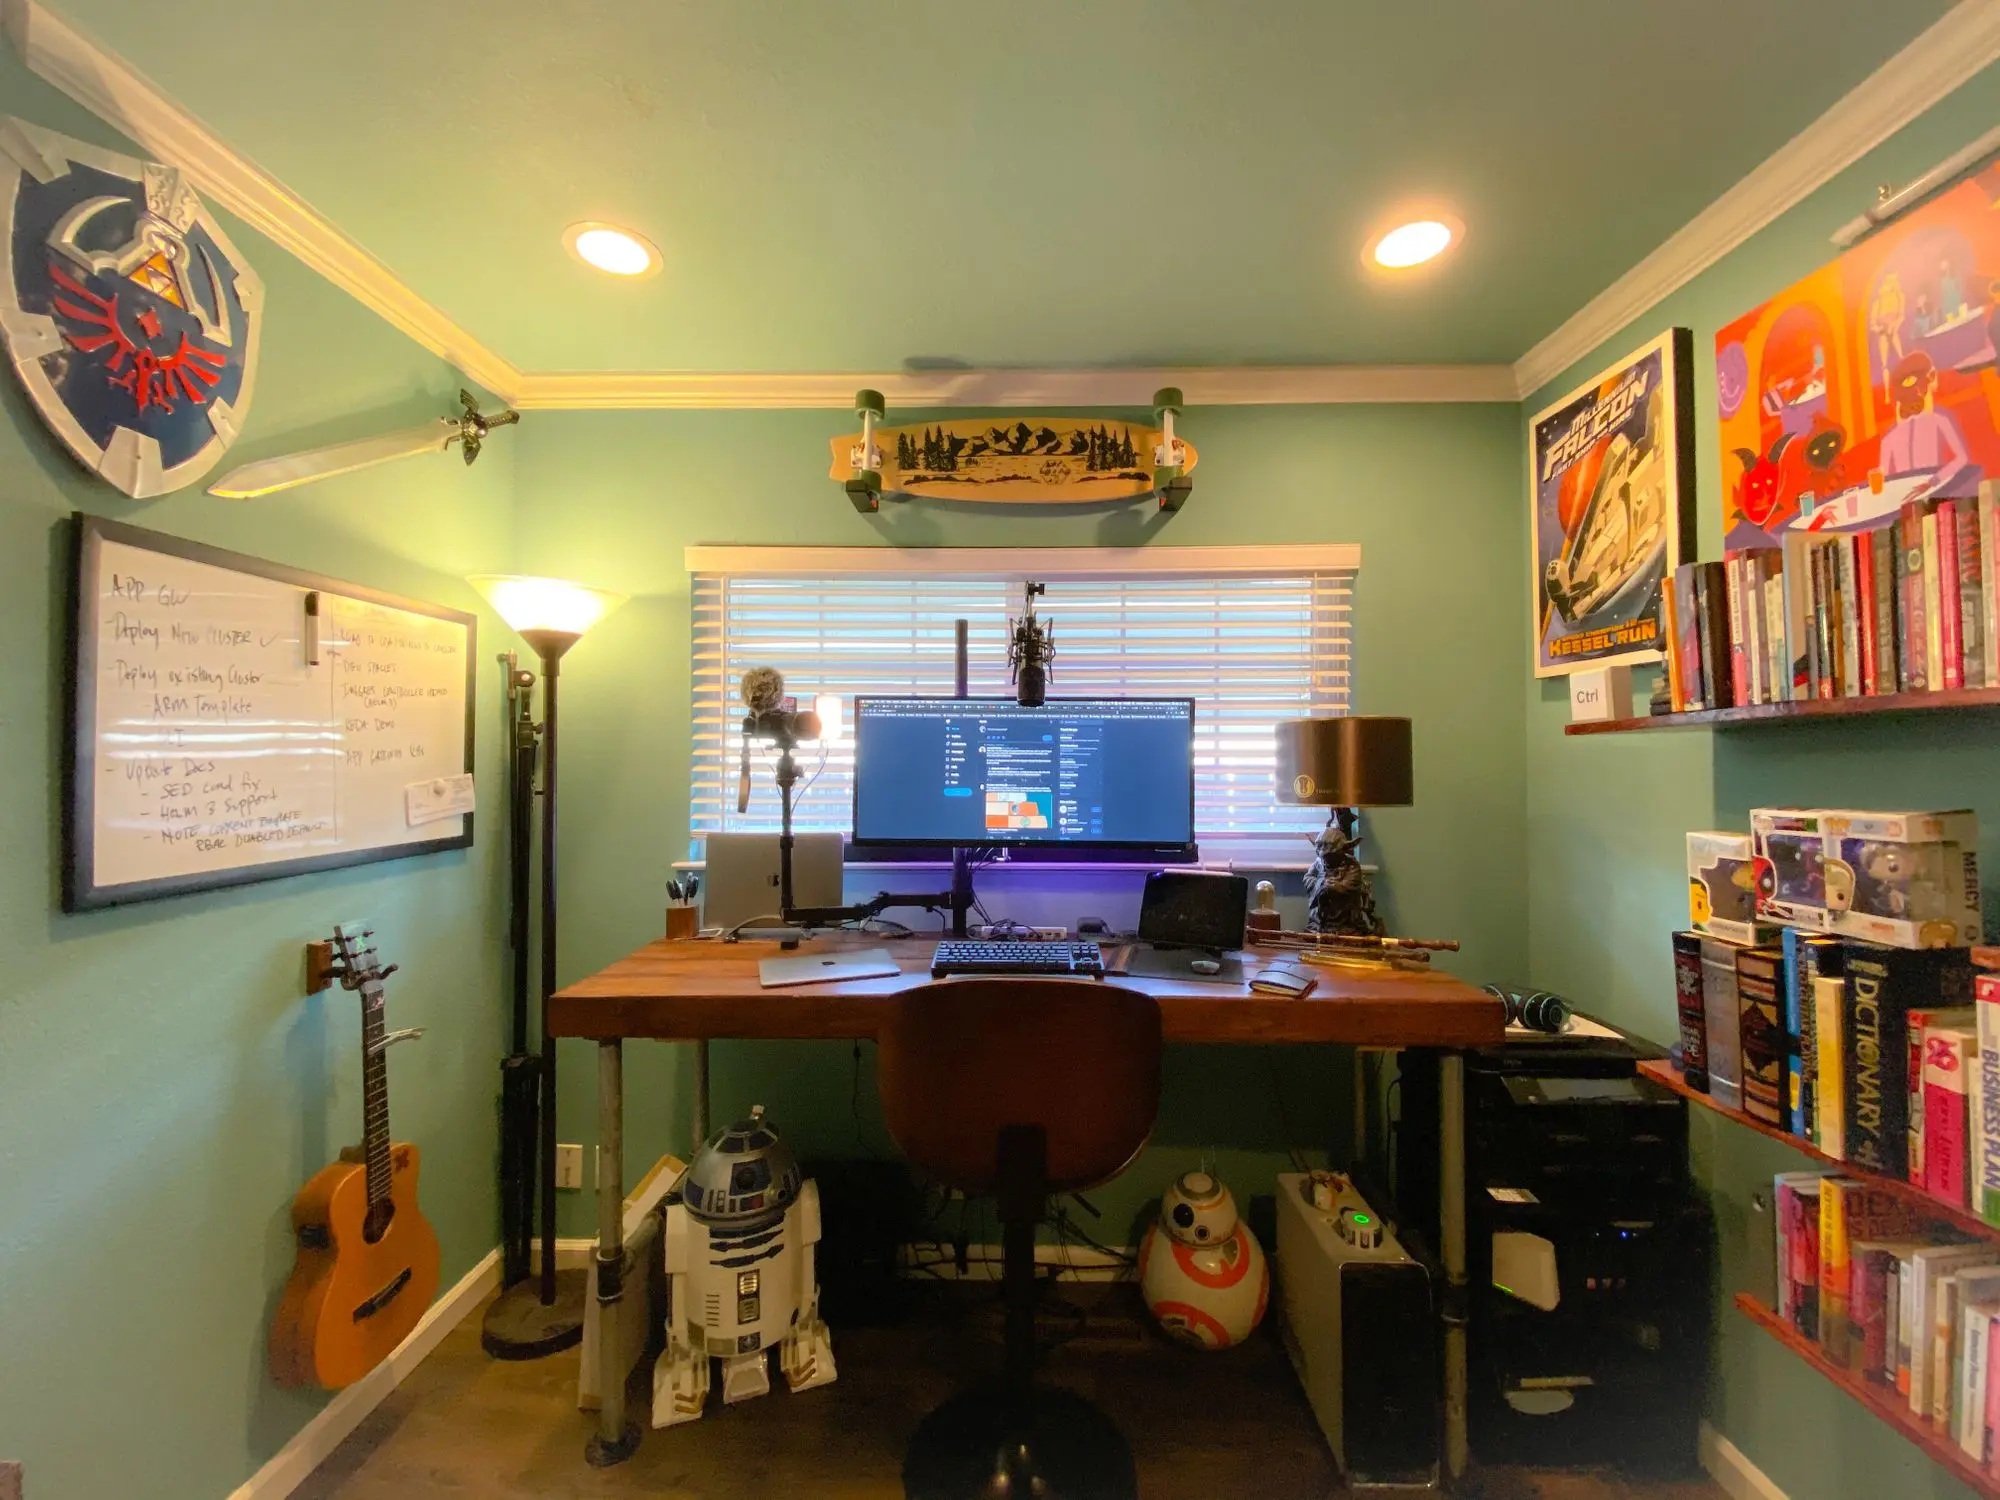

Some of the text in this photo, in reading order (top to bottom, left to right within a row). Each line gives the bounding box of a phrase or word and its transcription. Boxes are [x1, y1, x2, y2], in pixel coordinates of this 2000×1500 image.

[1543, 370, 1649, 481] FALCON
[1549, 634, 1614, 657] KESSEL
[1616, 620, 1656, 644] RUN
[115, 659, 158, 691] Deploy
[1576, 689, 1599, 704] Ctrl
[1962, 851, 1980, 913] MERCY
[1855, 977, 1882, 1138] DICTIONARY
[1982, 1048, 2000, 1190] BUSINESS PLAN
